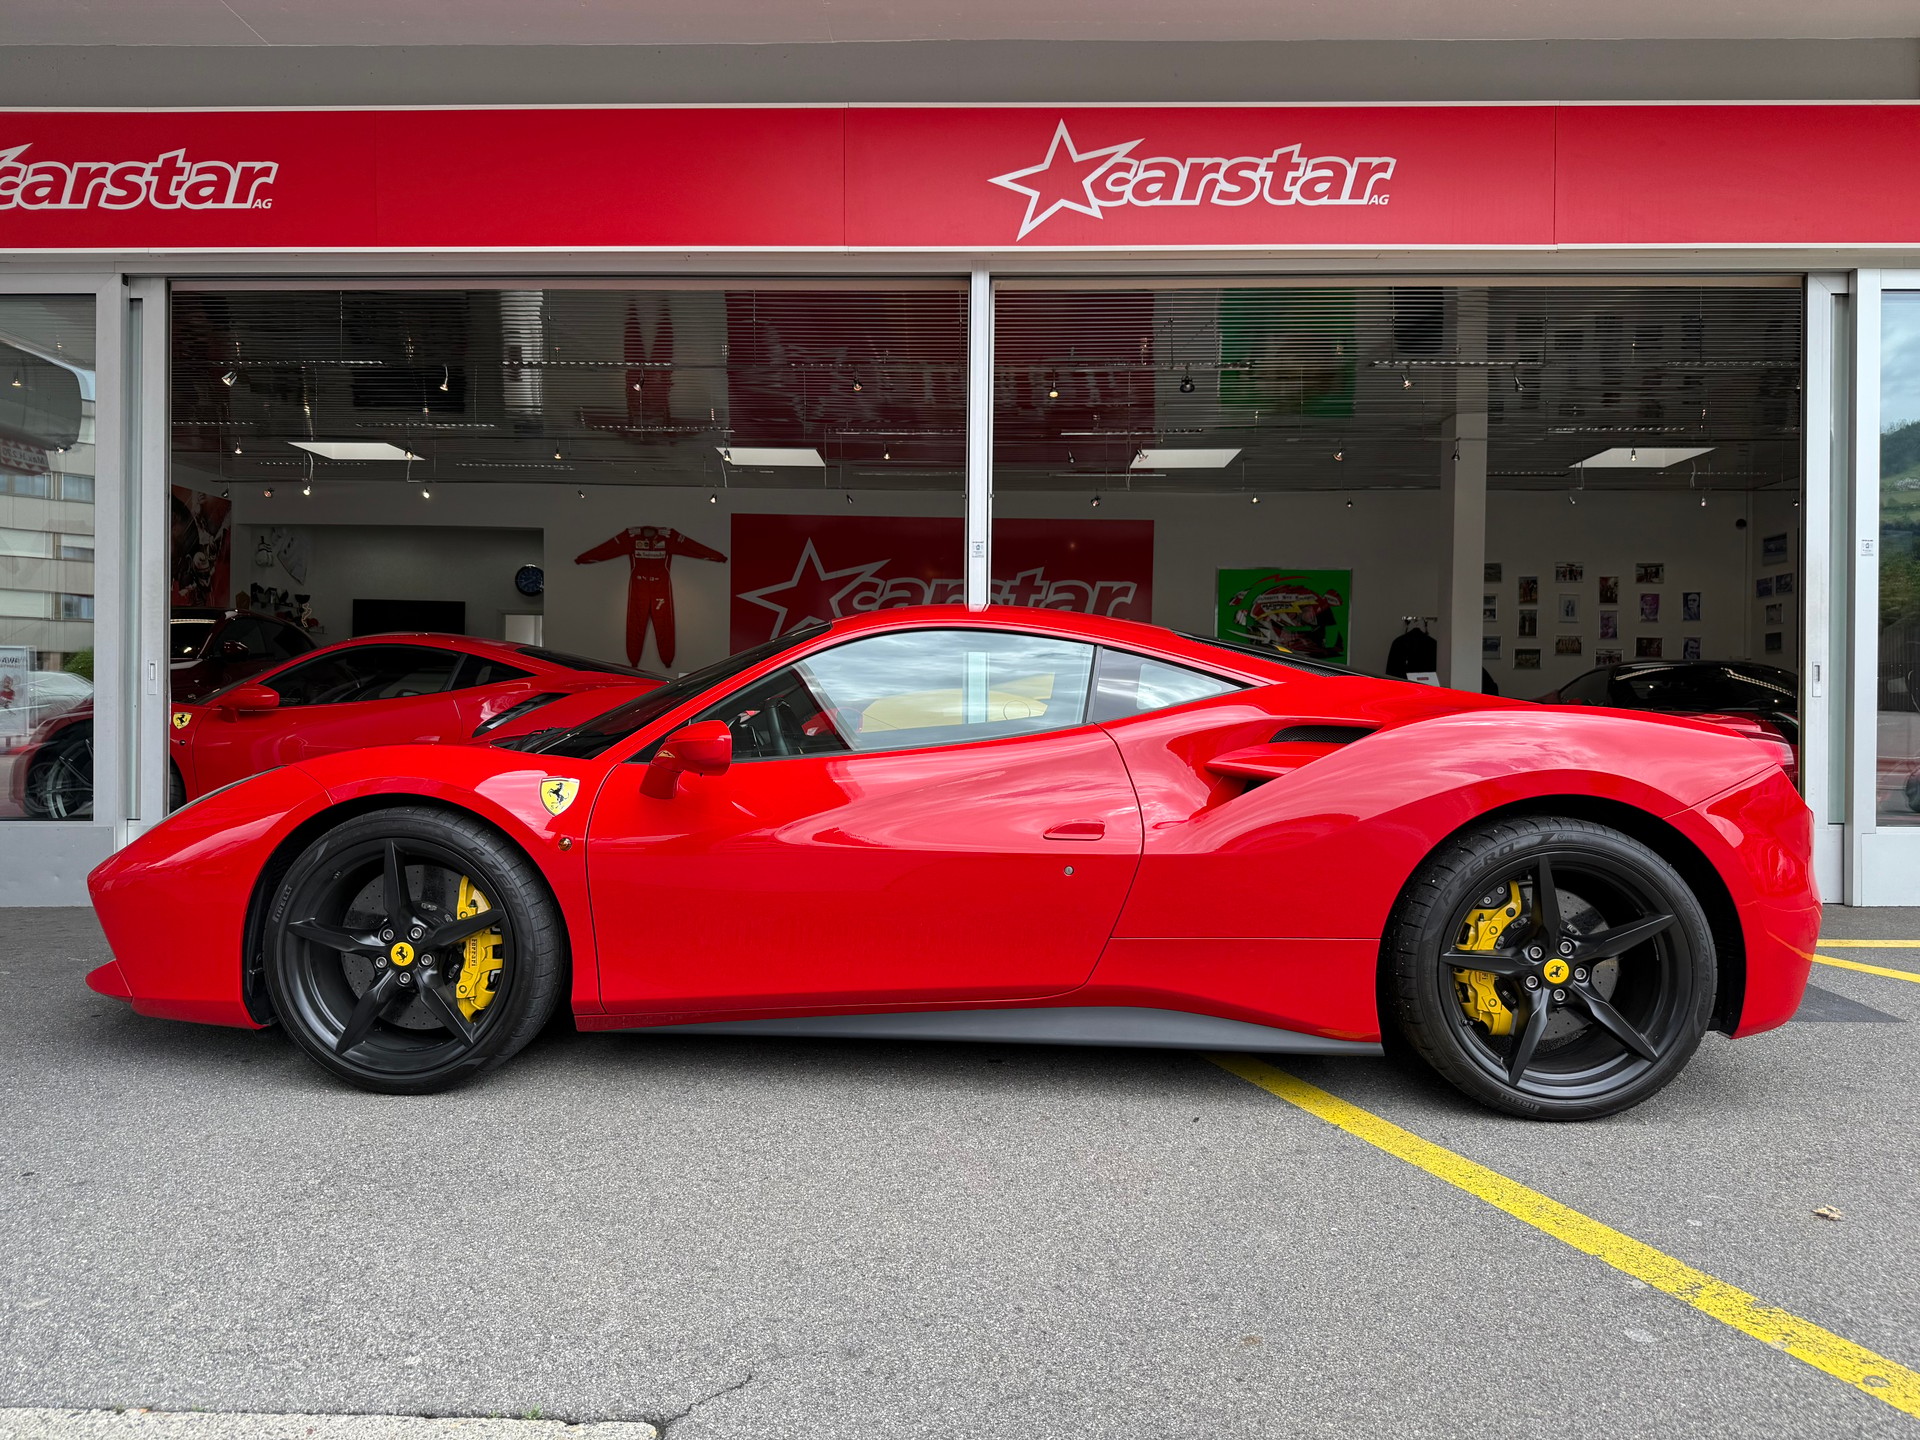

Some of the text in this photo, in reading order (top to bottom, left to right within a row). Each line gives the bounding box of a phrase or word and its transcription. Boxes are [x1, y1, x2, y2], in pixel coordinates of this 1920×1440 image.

[0, 148, 279, 210] carstar AG
[1091, 143, 1396, 206] carstar AG
[656, 598, 664, 610] 7
[838, 567, 1138, 616] cartar
[486, 860, 527, 917] ZERO
[1457, 843, 1515, 888] ZERO
[272, 884, 293, 923] PIRELLI
[470, 938, 478, 967] Ferrari
